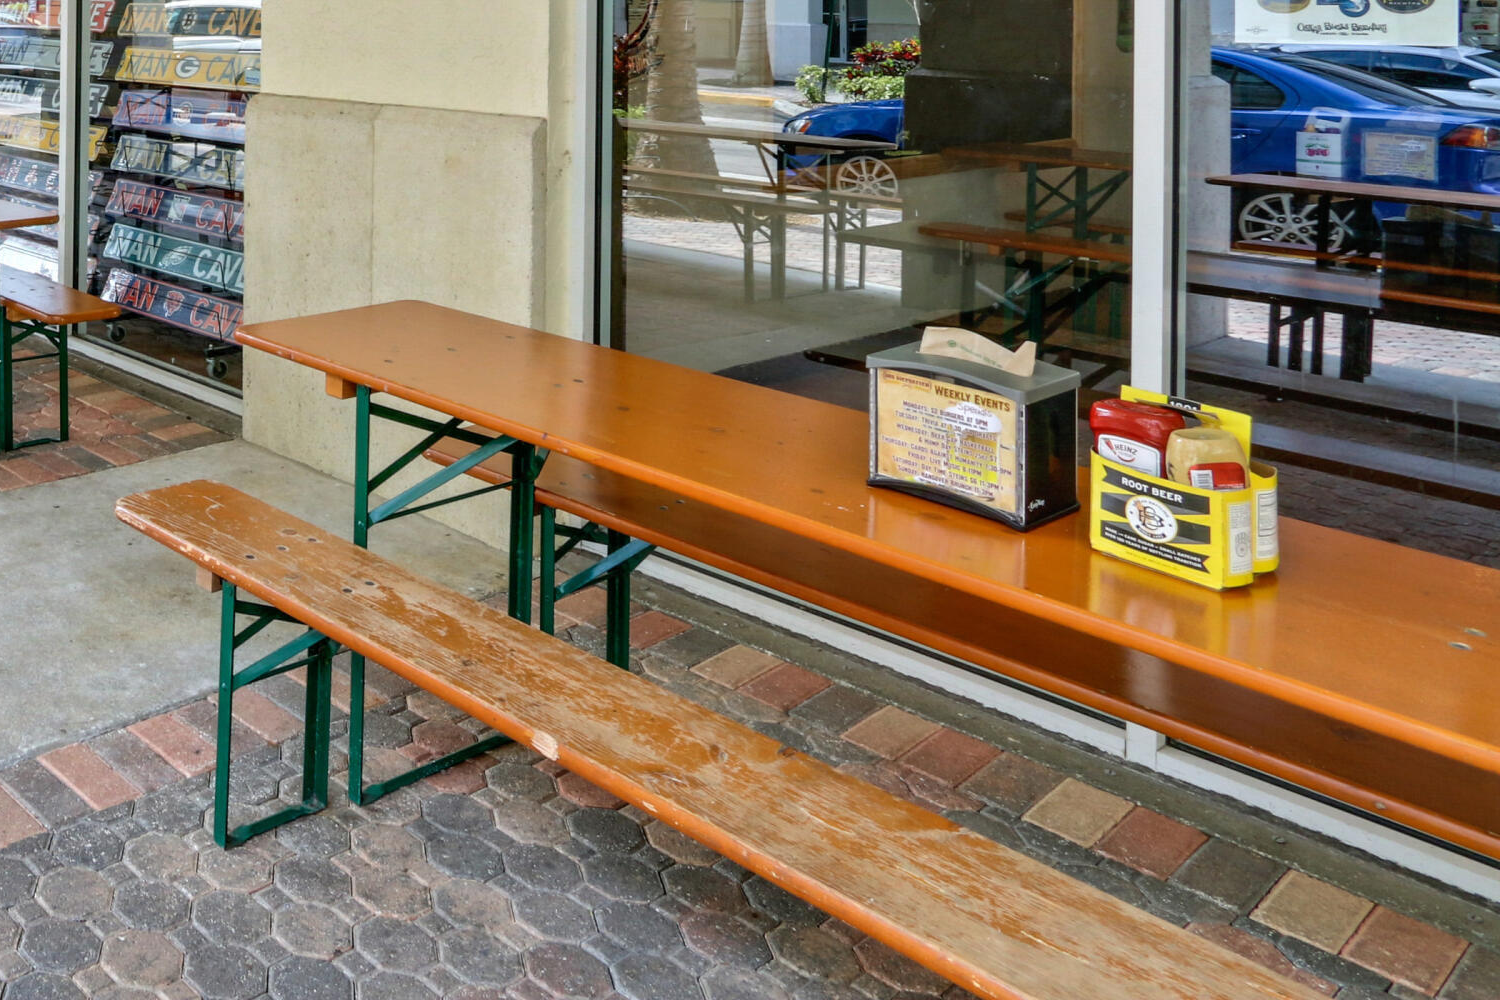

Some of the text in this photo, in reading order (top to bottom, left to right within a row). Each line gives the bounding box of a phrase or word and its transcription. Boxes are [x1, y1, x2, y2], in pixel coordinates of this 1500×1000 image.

[127, 8, 171, 33] MAN
[207, 7, 262, 35] CAVE
[127, 53, 172, 78] MAN
[115, 183, 165, 218] MAN
[113, 229, 162, 265] MAN
[934, 384, 1011, 412] WEEKLY EVENTS
[1114, 443, 1137, 456] HEINZ
[1121, 476, 1183, 504] ROOT BEER
